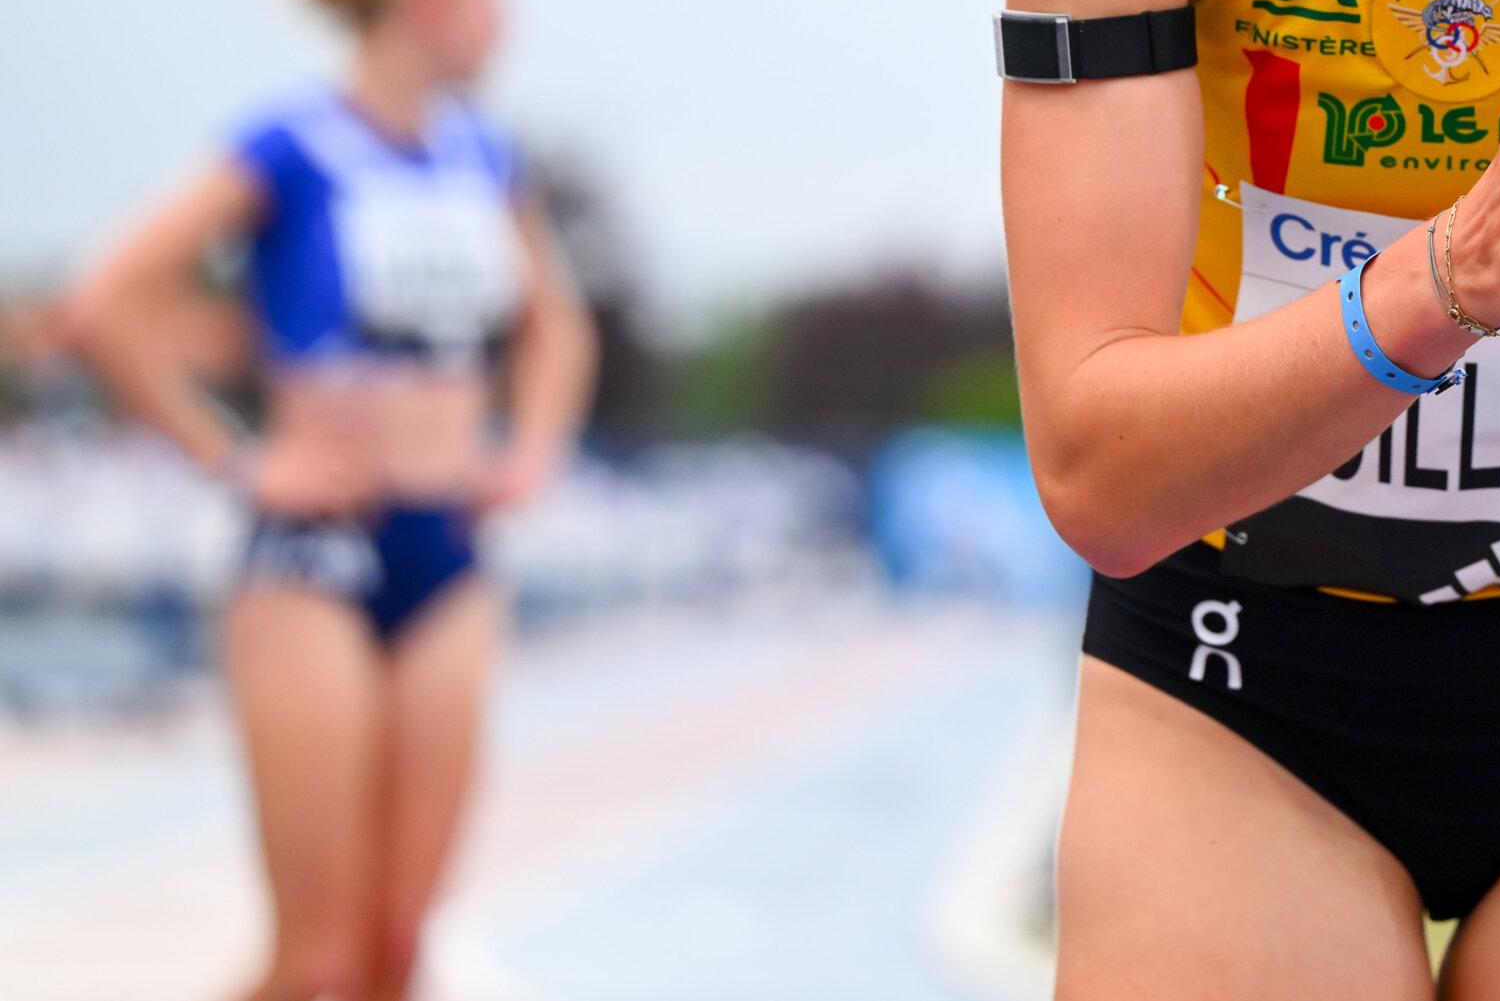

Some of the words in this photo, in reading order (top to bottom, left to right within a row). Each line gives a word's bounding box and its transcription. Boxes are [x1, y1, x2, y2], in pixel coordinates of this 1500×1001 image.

[1235, 19, 1377, 57] FNISTÈRE
[1380, 155, 1491, 172] enviro
[1270, 213, 1377, 271] Cré
